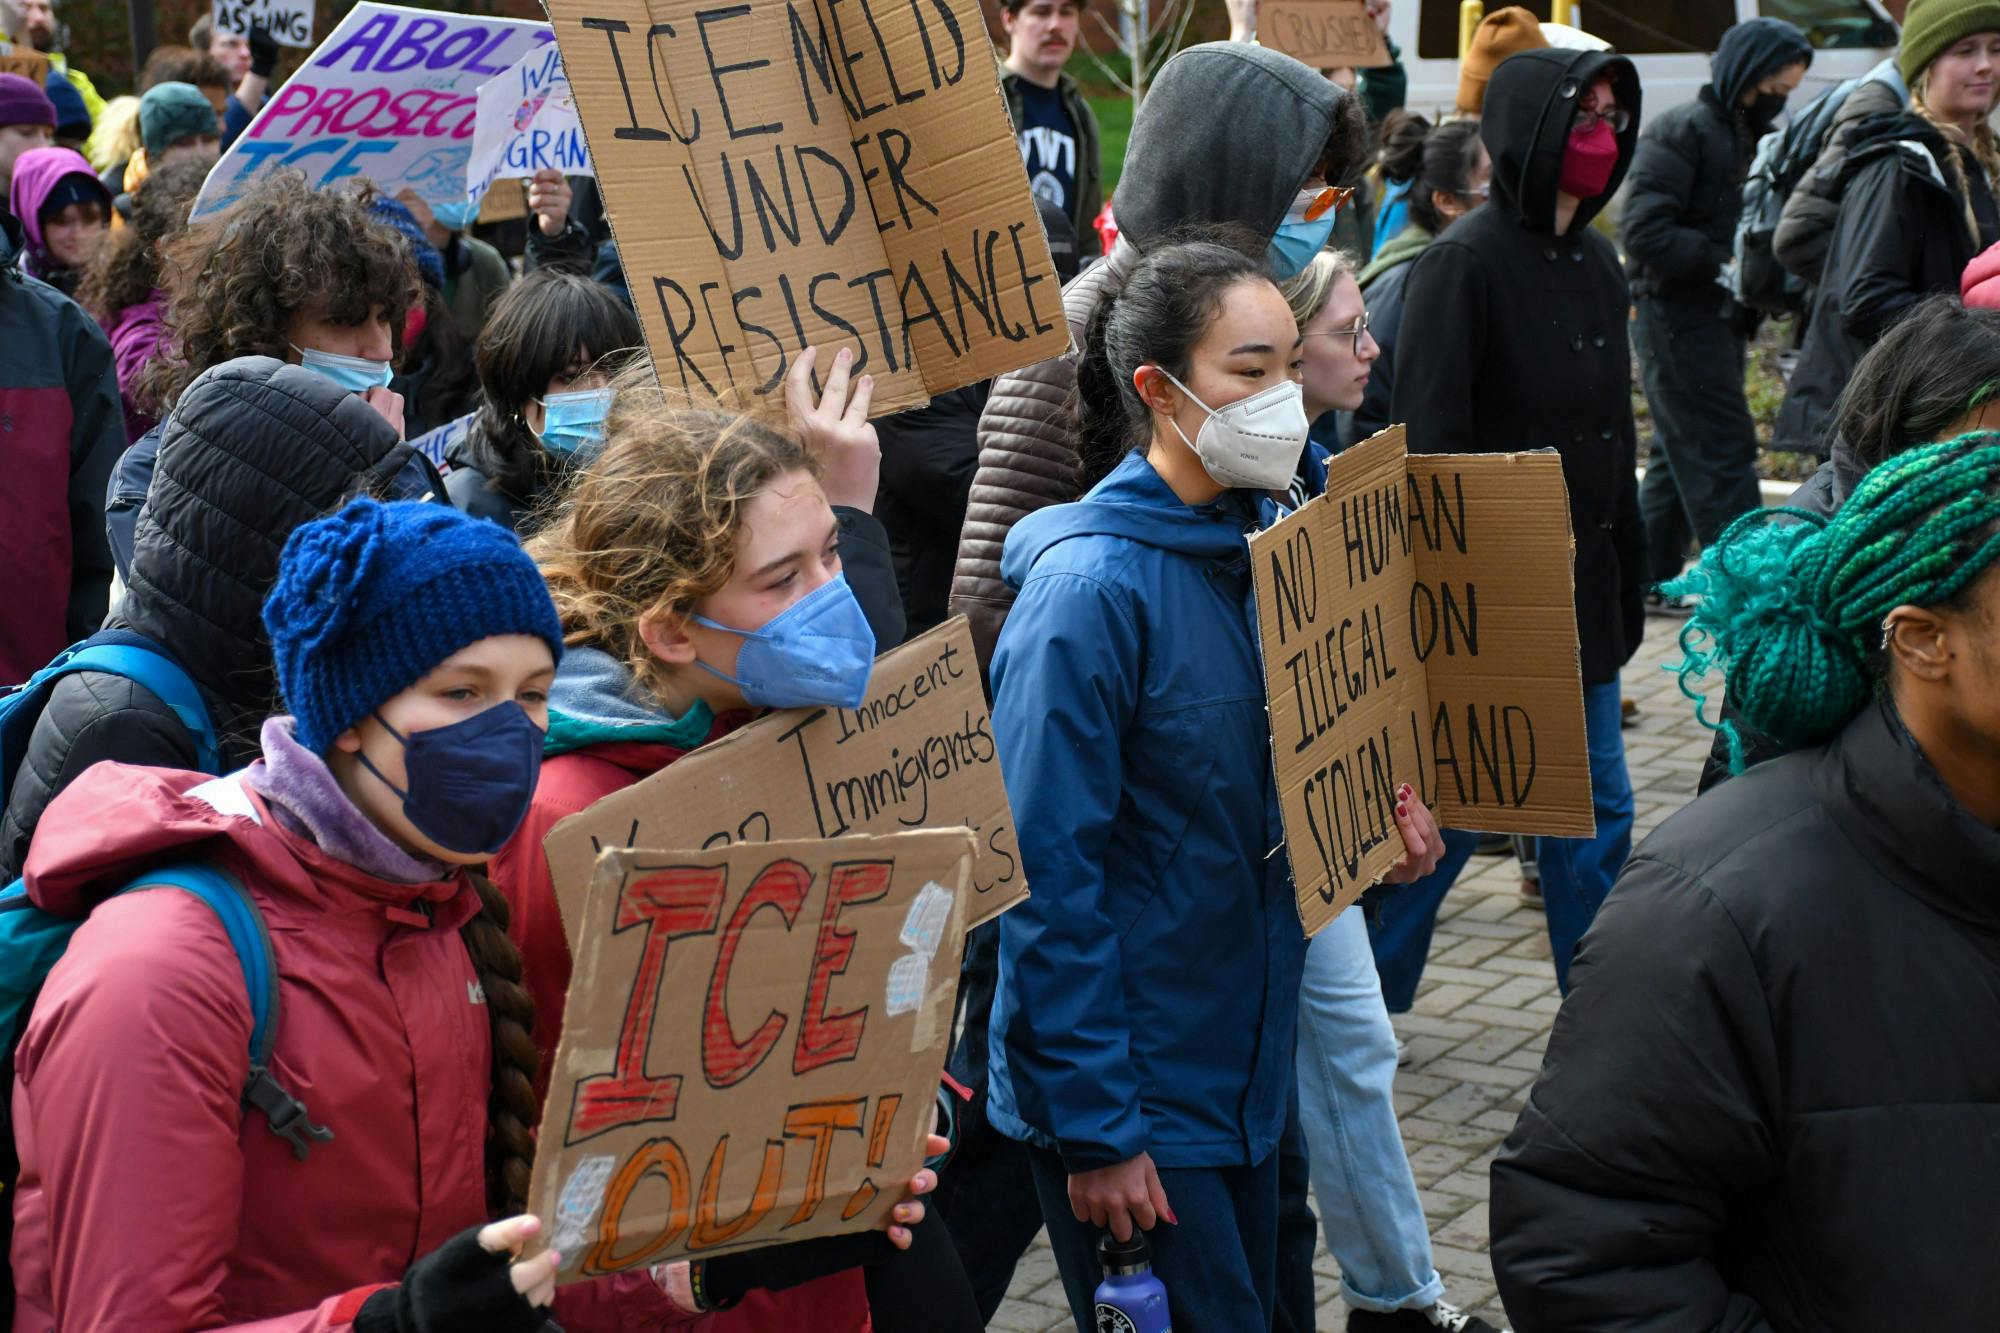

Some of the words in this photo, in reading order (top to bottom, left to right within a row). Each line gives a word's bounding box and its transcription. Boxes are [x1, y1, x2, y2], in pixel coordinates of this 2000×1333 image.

[582, 4, 783, 145] ICE
[682, 129, 939, 261] UNDER
[653, 222, 1053, 407] RESISTANCE
[1271, 526, 1316, 645] NO
[1341, 473, 1468, 589] HUMAN
[836, 641, 963, 744] Innocent
[1286, 603, 1396, 754] ILLEGAL
[1410, 581, 1479, 663] ON
[826, 710, 995, 838] Immigrants
[1303, 726, 1397, 905] STOLEN
[1411, 700, 1536, 808] LAND
[564, 857, 895, 1147] ICE
[580, 1093, 903, 1276] OUT!
